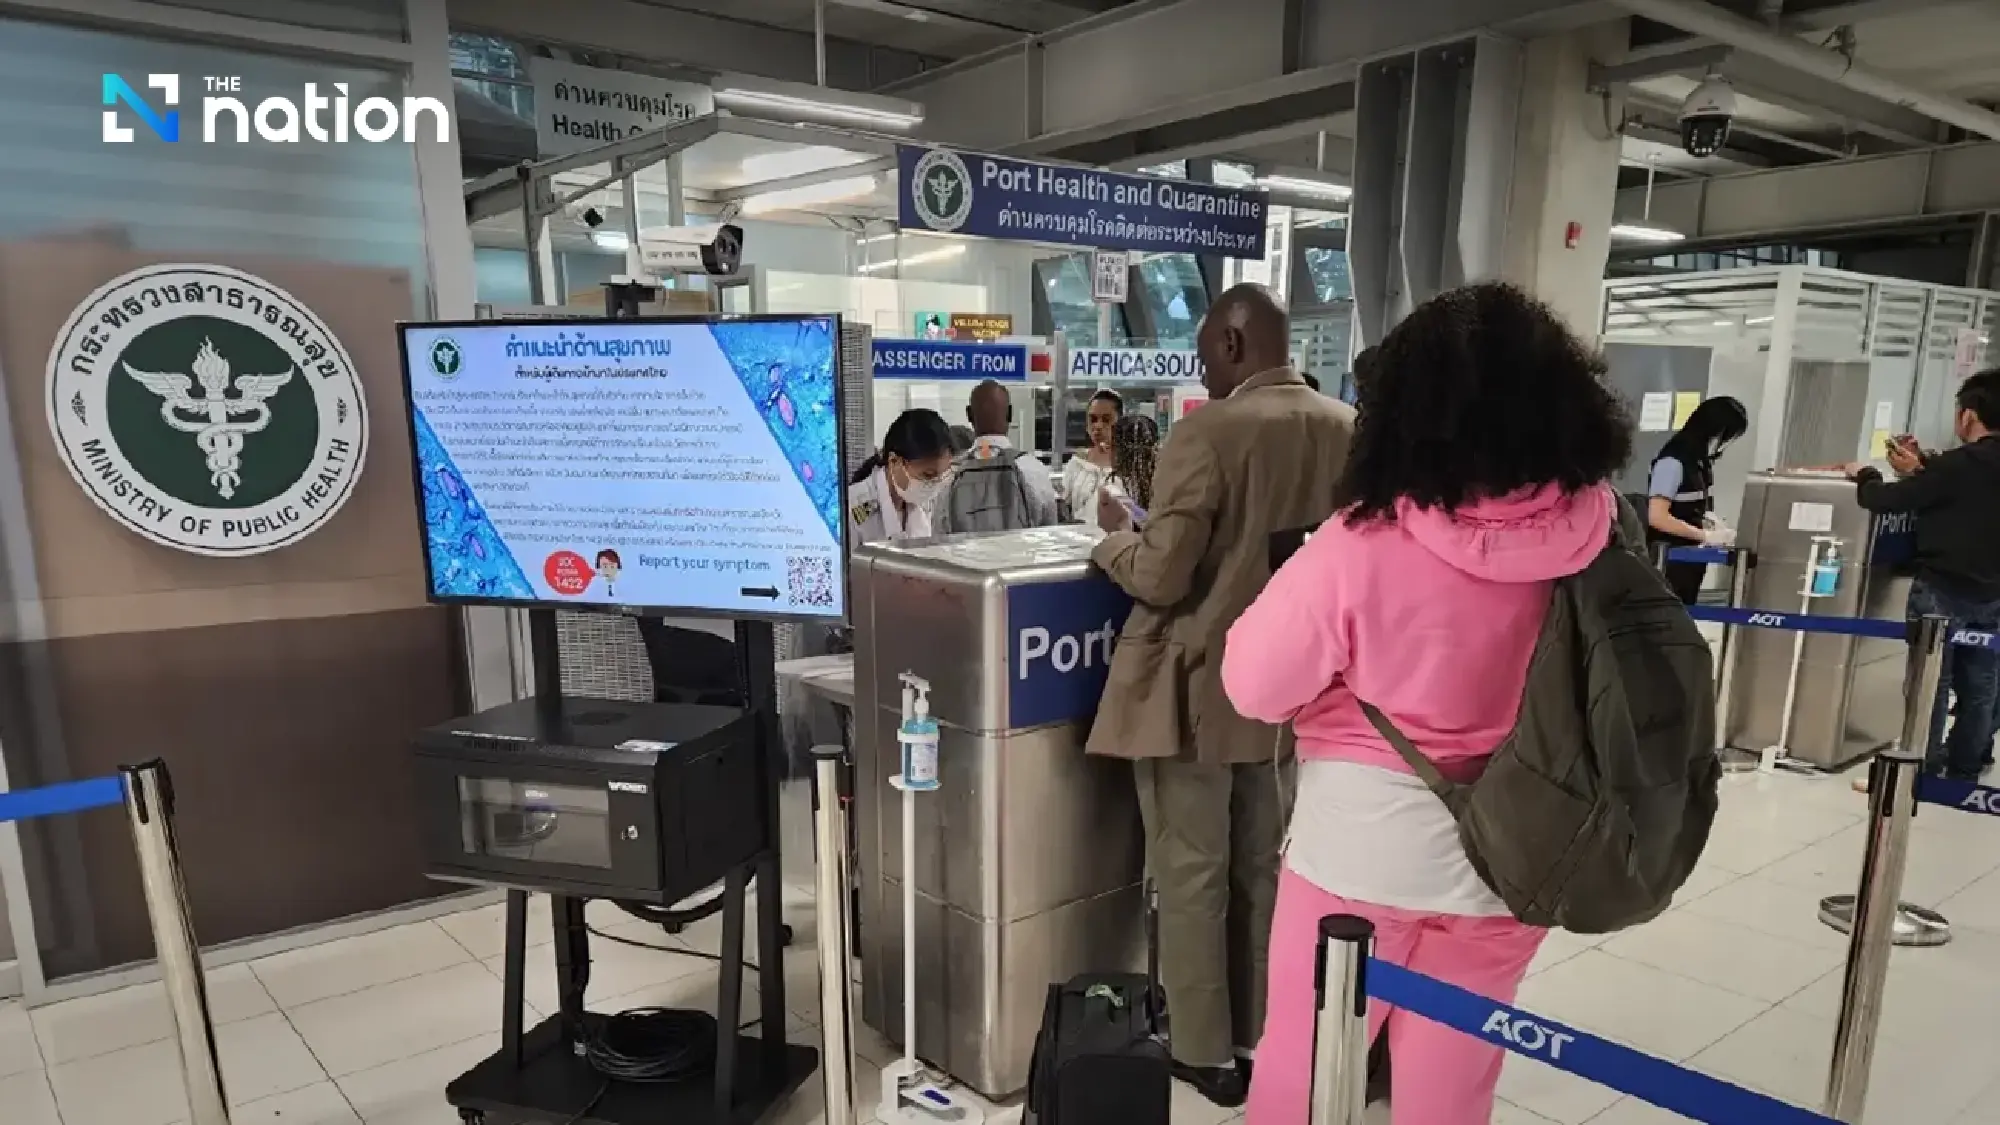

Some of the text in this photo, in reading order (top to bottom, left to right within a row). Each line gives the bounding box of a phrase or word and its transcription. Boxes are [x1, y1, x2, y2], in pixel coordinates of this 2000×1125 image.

[554, 78, 696, 122] ด่านควบคุมโรค
[552, 114, 622, 142] Health
[982, 159, 1032, 192] Port
[1037, 167, 1109, 203] Health
[1113, 182, 1152, 206] and
[1157, 184, 1261, 219] Quarantine
[999, 203, 1256, 250] ด่านควบคุมโรคติดต่อระหว่างประเทศ
[70, 281, 339, 380] กระทรวงสาธารณสุข
[505, 331, 672, 364] คำแนะนำด้านสุขภาพ
[871, 349, 1016, 373] ASSENGER FROM
[1071, 351, 1204, 378] AFRICA SOUT
[81, 438, 350, 538] MINISTRY OF PUBLIC HEALTH
[639, 553, 679, 569] Report
[681, 557, 709, 571] your
[1748, 613, 1786, 627] AOT
[1019, 617, 1116, 680] Port
[1951, 630, 1995, 646] AOT
[1961, 789, 2000, 812] AO
[1481, 1009, 1575, 1061] AOT
